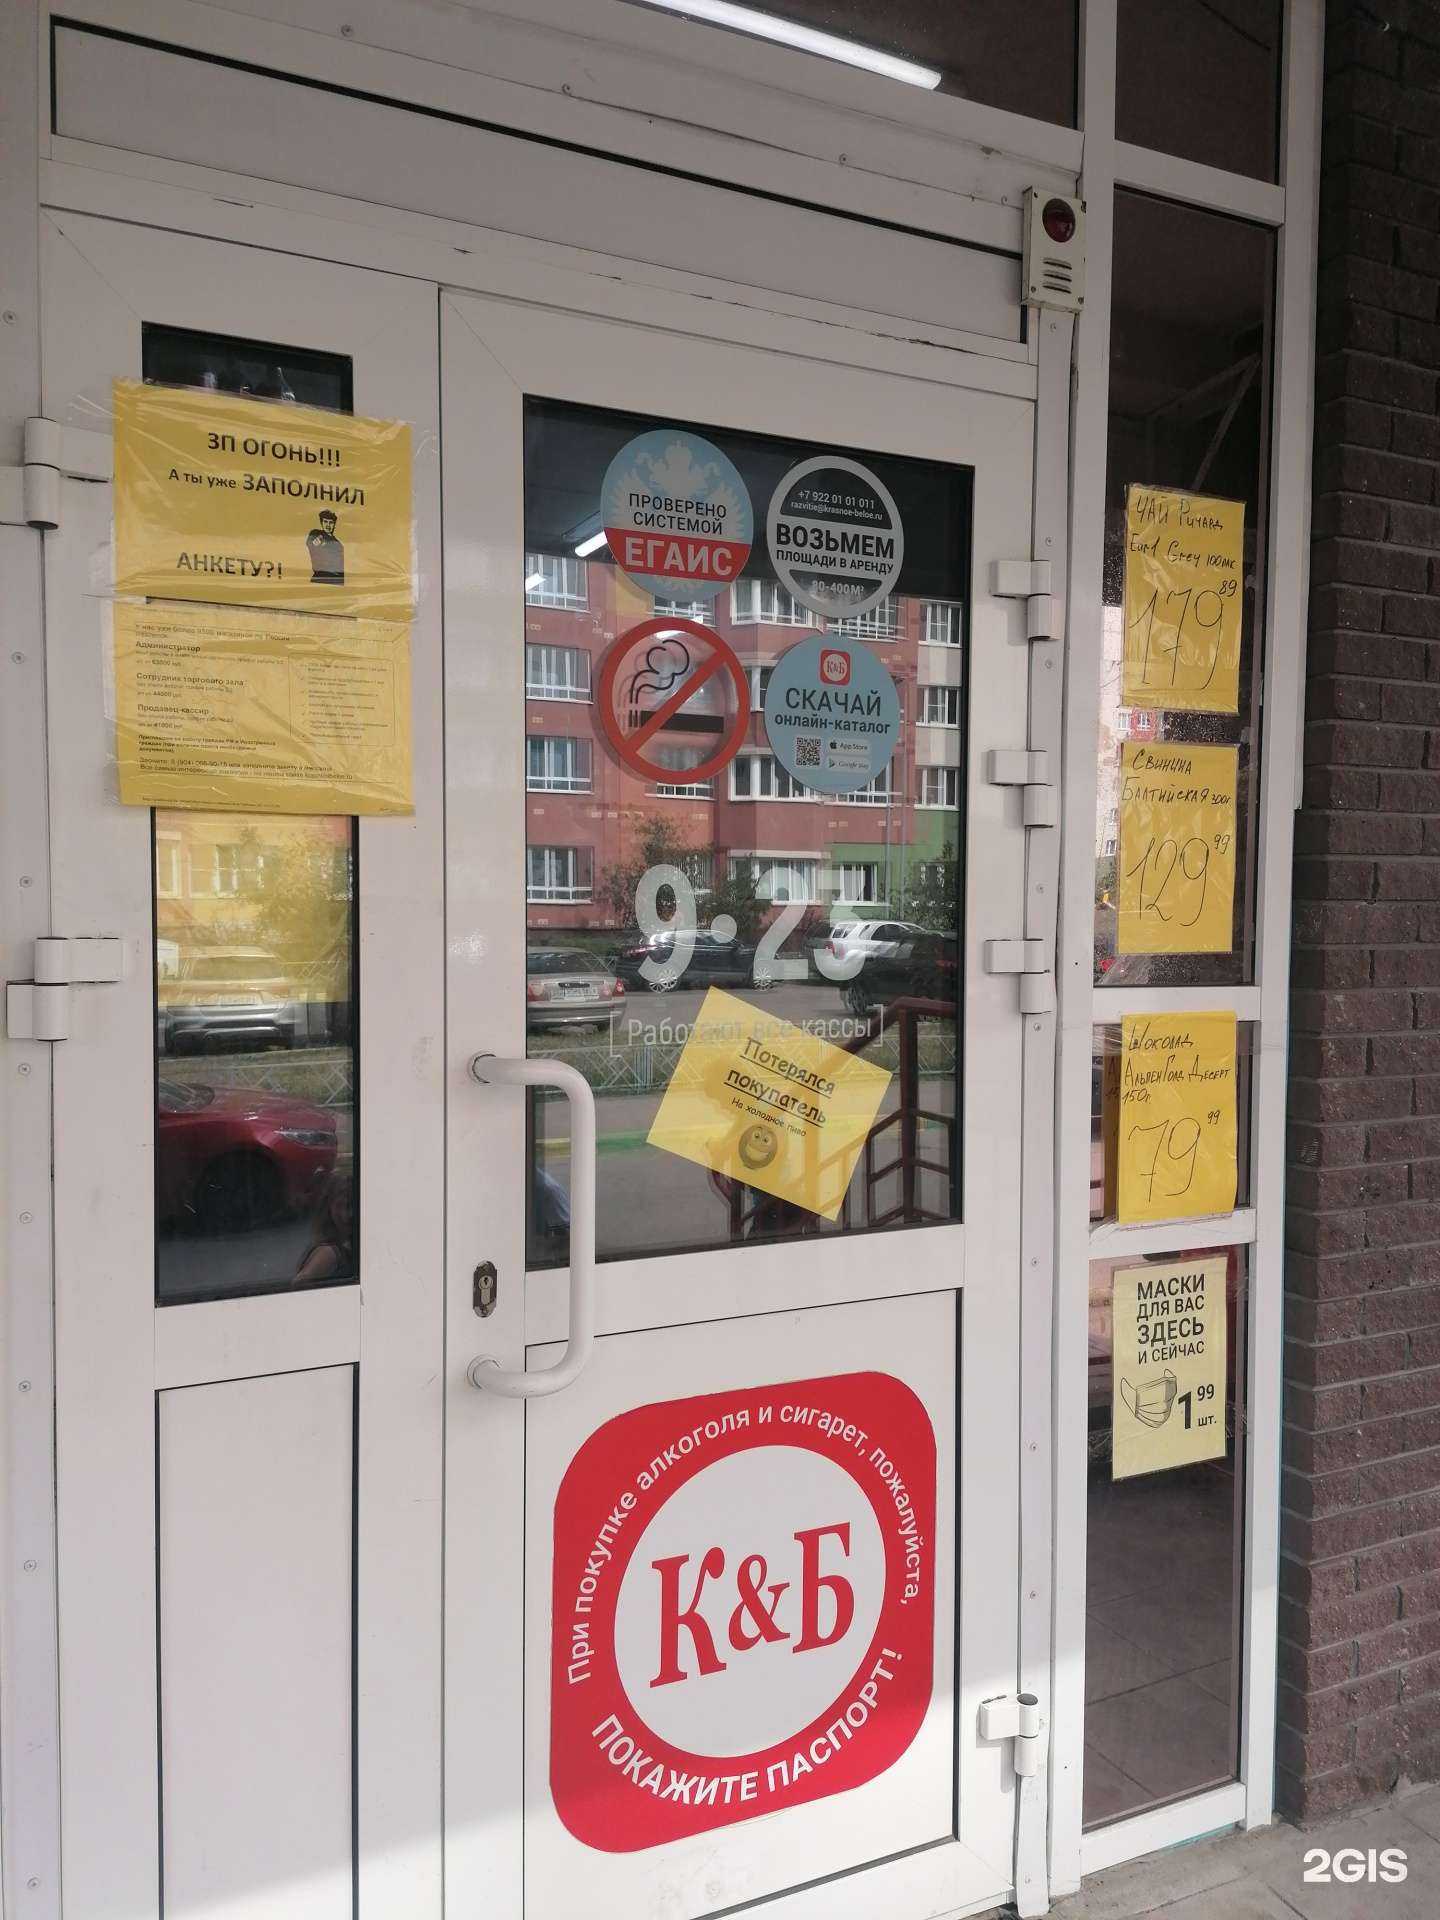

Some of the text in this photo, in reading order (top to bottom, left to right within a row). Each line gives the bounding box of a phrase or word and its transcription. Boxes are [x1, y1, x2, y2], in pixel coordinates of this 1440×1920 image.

[207, 432, 341, 467] ЗП ОГОНЬ!!!
[168, 468, 365, 506] А ты уже ЗАПОЛНИЛ
[812, 492, 830, 504] 922
[832, 495, 842, 505] 01
[845, 497, 855, 507] 01
[859, 498, 875, 509] 011
[629, 493, 727, 519] ПРОВЕРЕНО
[633, 511, 723, 535] СИСТЕМОЙ
[776, 523, 895, 559] ВОЗЬМЕМ
[176, 551, 283, 580] АНКЕТУ?!
[625, 537, 732, 576] ЕГАИС
[776, 549, 894, 575] ПЛОЩАДИ В АРЕНДУ
[1128, 579, 1238, 691] 179 89
[785, 687, 881, 717] СКАЧАЙ
[774, 713, 891, 734] онлайн-каталог
[1126, 833, 1231, 927] 129 99
[802, 1018, 872, 1039] кассы
[744, 1036, 836, 1096] Потерялся
[727, 1069, 826, 1124] покупатель
[731, 1097, 743, 1109] На
[745, 1105, 785, 1127] холодное
[1128, 1110, 1221, 1202] 79 99
[1137, 1273, 1205, 1300] МАСКИ
[1137, 1295, 1204, 1322] ДЛЯ ВАС
[1138, 1317, 1204, 1346] ЗДЕСЬ
[1138, 1340, 1204, 1365] И СЕЙЧАС
[1177, 1384, 1215, 1430] 1 99
[1198, 1414, 1217, 1427] шт.
[567, 1405, 921, 1685] При покупке алкоголя и сигарет, пожалуйста,
[649, 1521, 855, 1688] К&Б
[592, 1647, 904, 1806] ПОКАЖИТЕ ПАСПОРТ!
